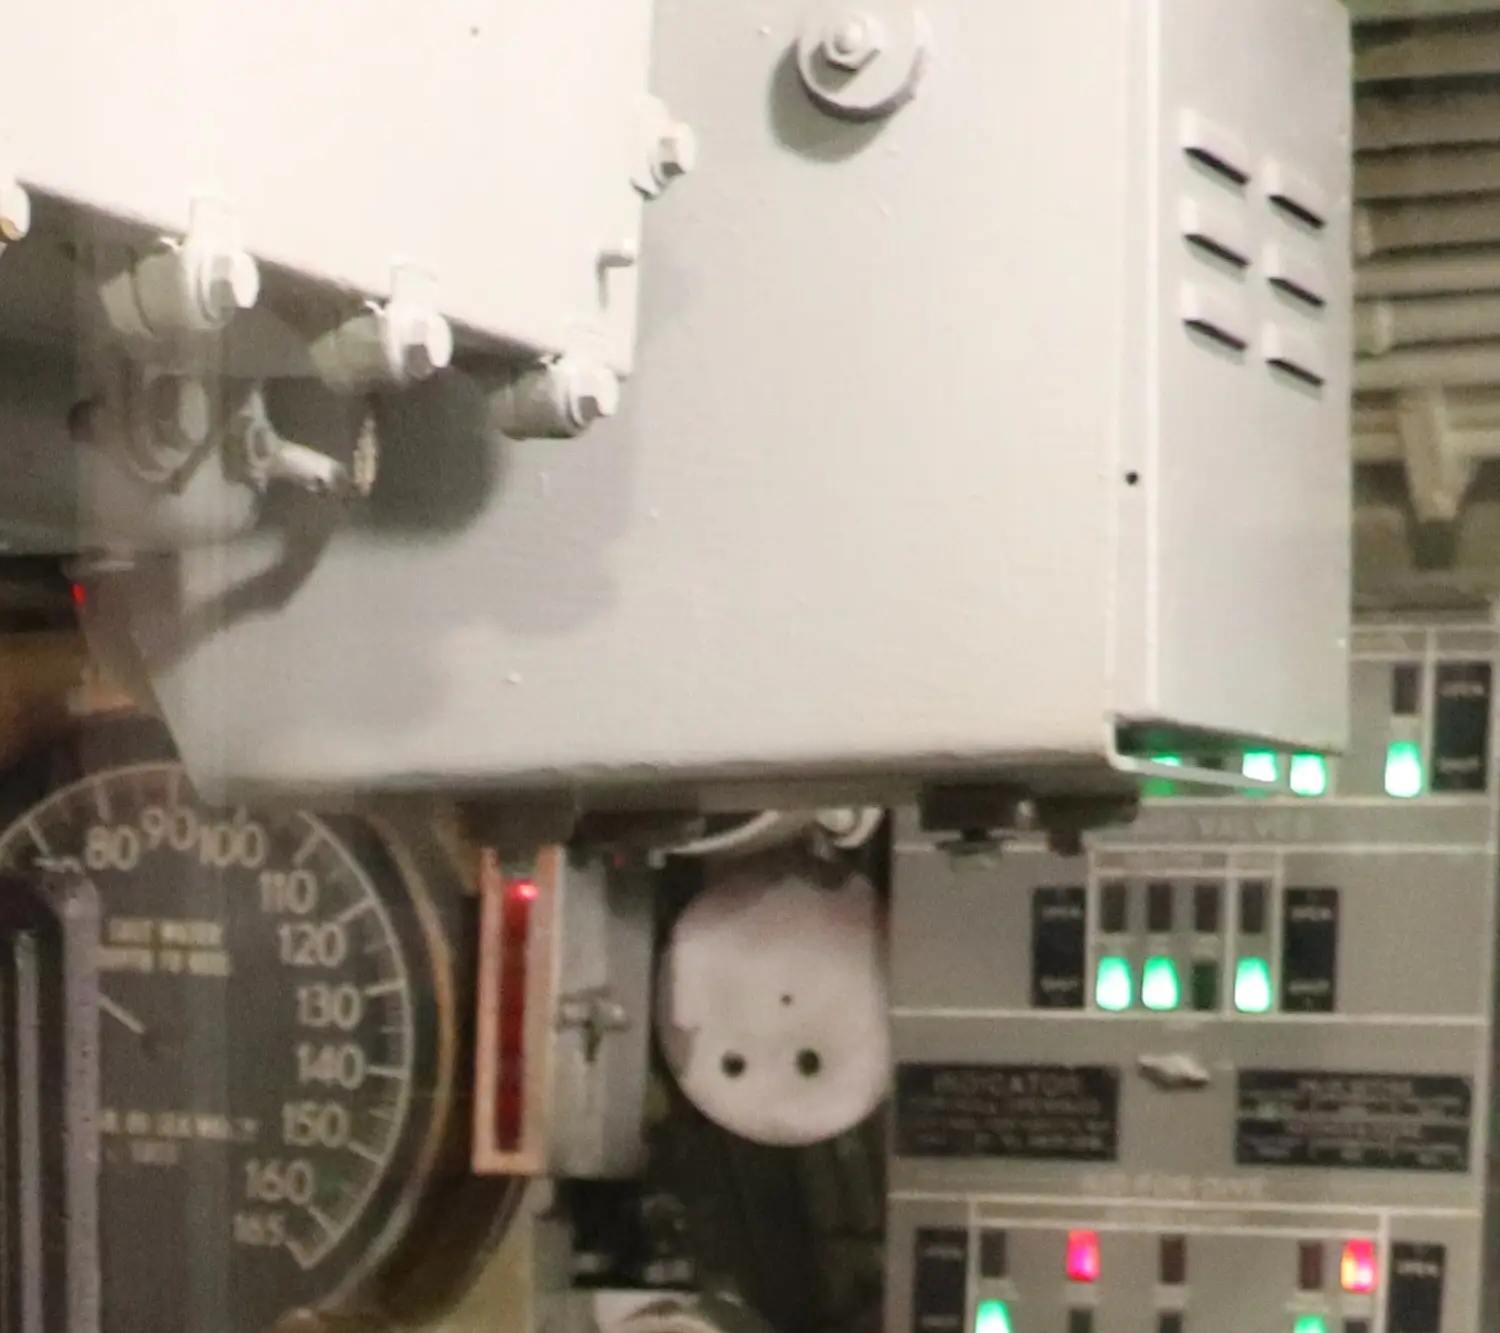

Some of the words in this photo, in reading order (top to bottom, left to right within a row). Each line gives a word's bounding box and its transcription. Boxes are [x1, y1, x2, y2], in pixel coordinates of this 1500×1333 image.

[86, 824, 140, 872] 80
[141, 806, 197, 852] 90
[199, 822, 266, 869] 100
[259, 869, 318, 915] 110
[278, 921, 348, 968] 120
[298, 984, 362, 1030] 130
[298, 1044, 365, 1091] 140
[281, 1101, 350, 1150] 150
[245, 1158, 314, 1204] 160
